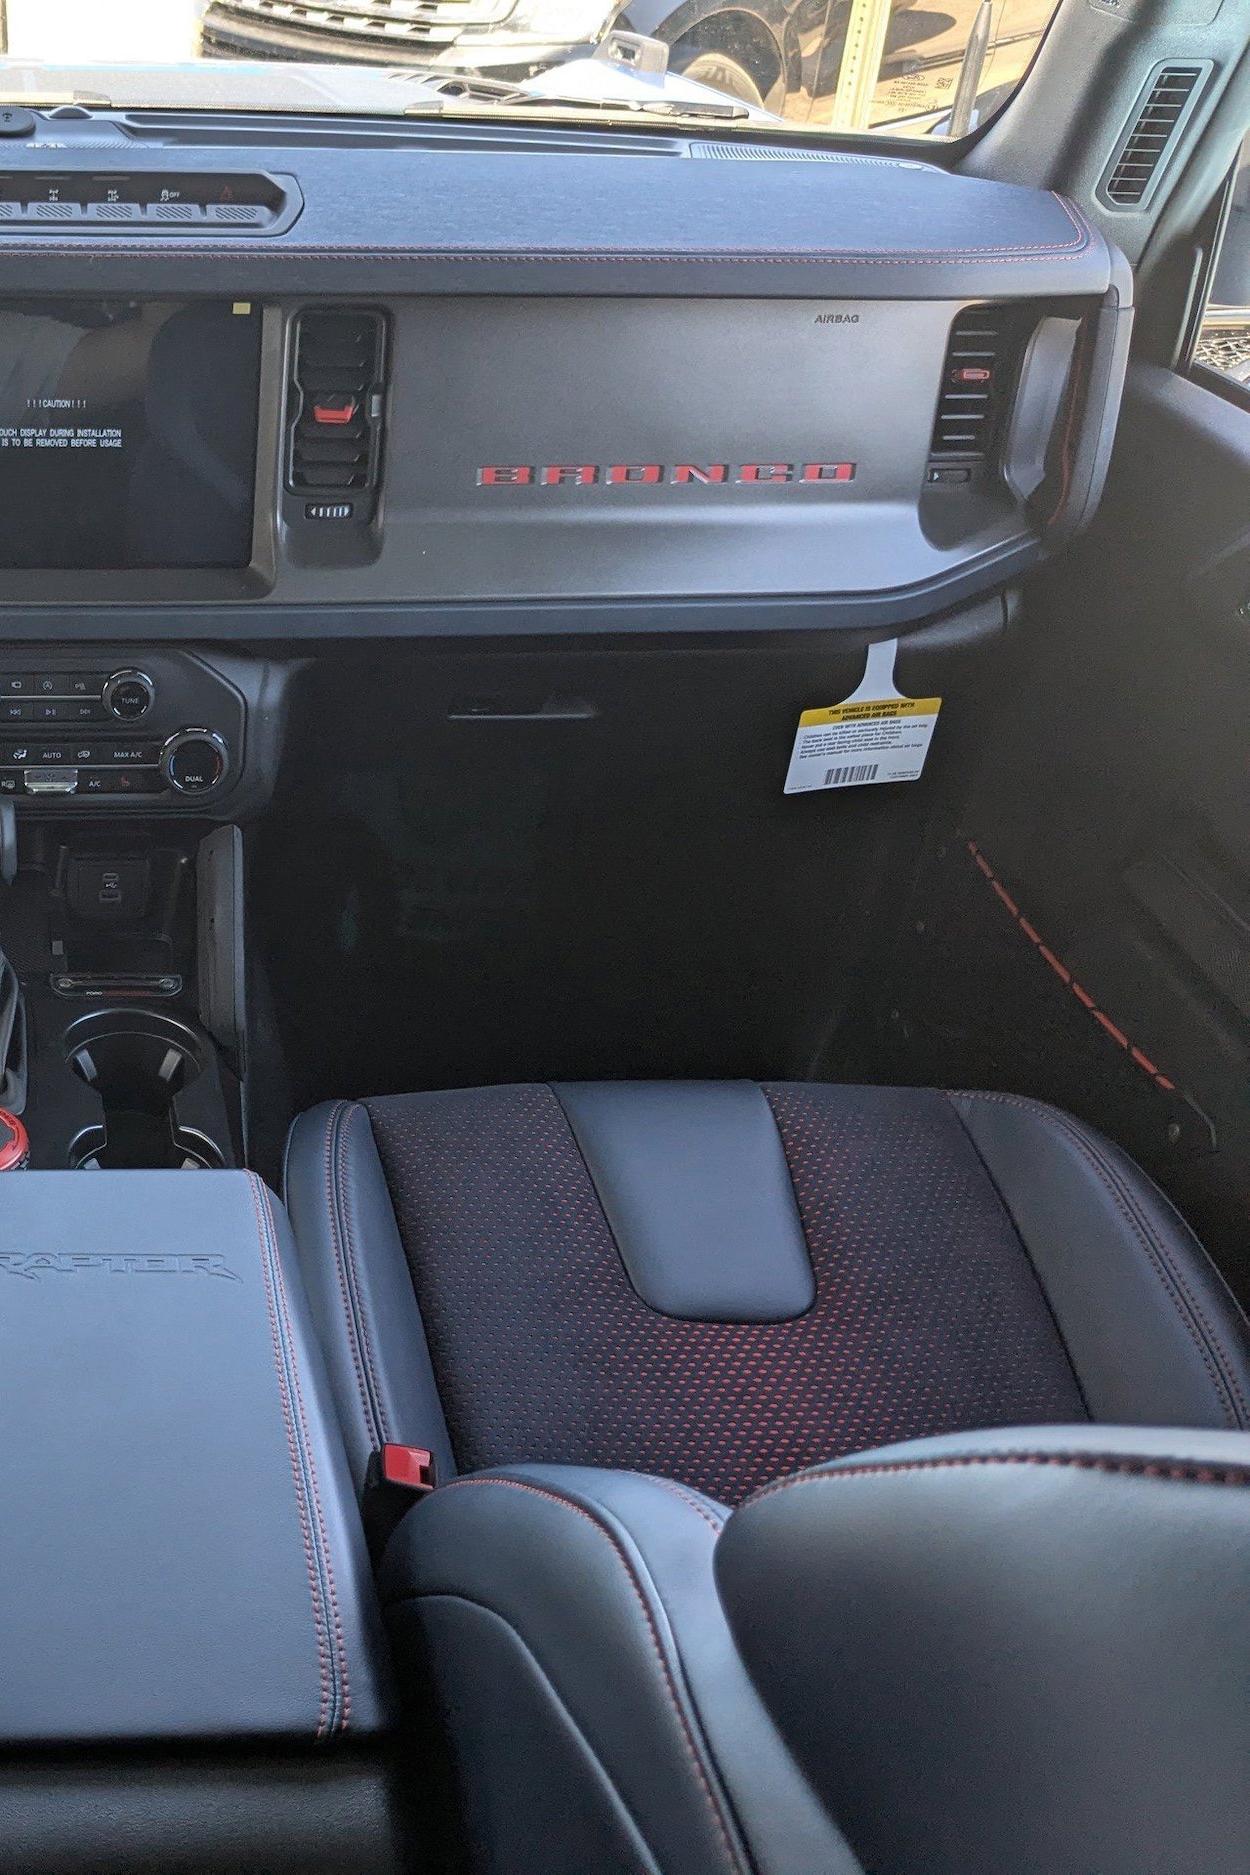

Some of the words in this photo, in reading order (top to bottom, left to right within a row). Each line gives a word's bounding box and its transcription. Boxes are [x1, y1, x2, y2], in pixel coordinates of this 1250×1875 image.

[813, 314, 860, 324] AIRBAG
[20, 428, 47, 437] DISPLAY
[50, 428, 74, 437] DURING
[77, 428, 122, 437] INSTALLATION
[2, 438, 9, 447] IS
[12, 438, 21, 447] TO
[23, 438, 33, 447] BE
[36, 438, 68, 447] REMOVED
[71, 438, 97, 447] BEFORE
[100, 438, 122, 447] USAGE
[476, 463, 856, 487] BRONCO
[120, 696, 141, 704] TUNE
[184, 775, 204, 783] DUAL
